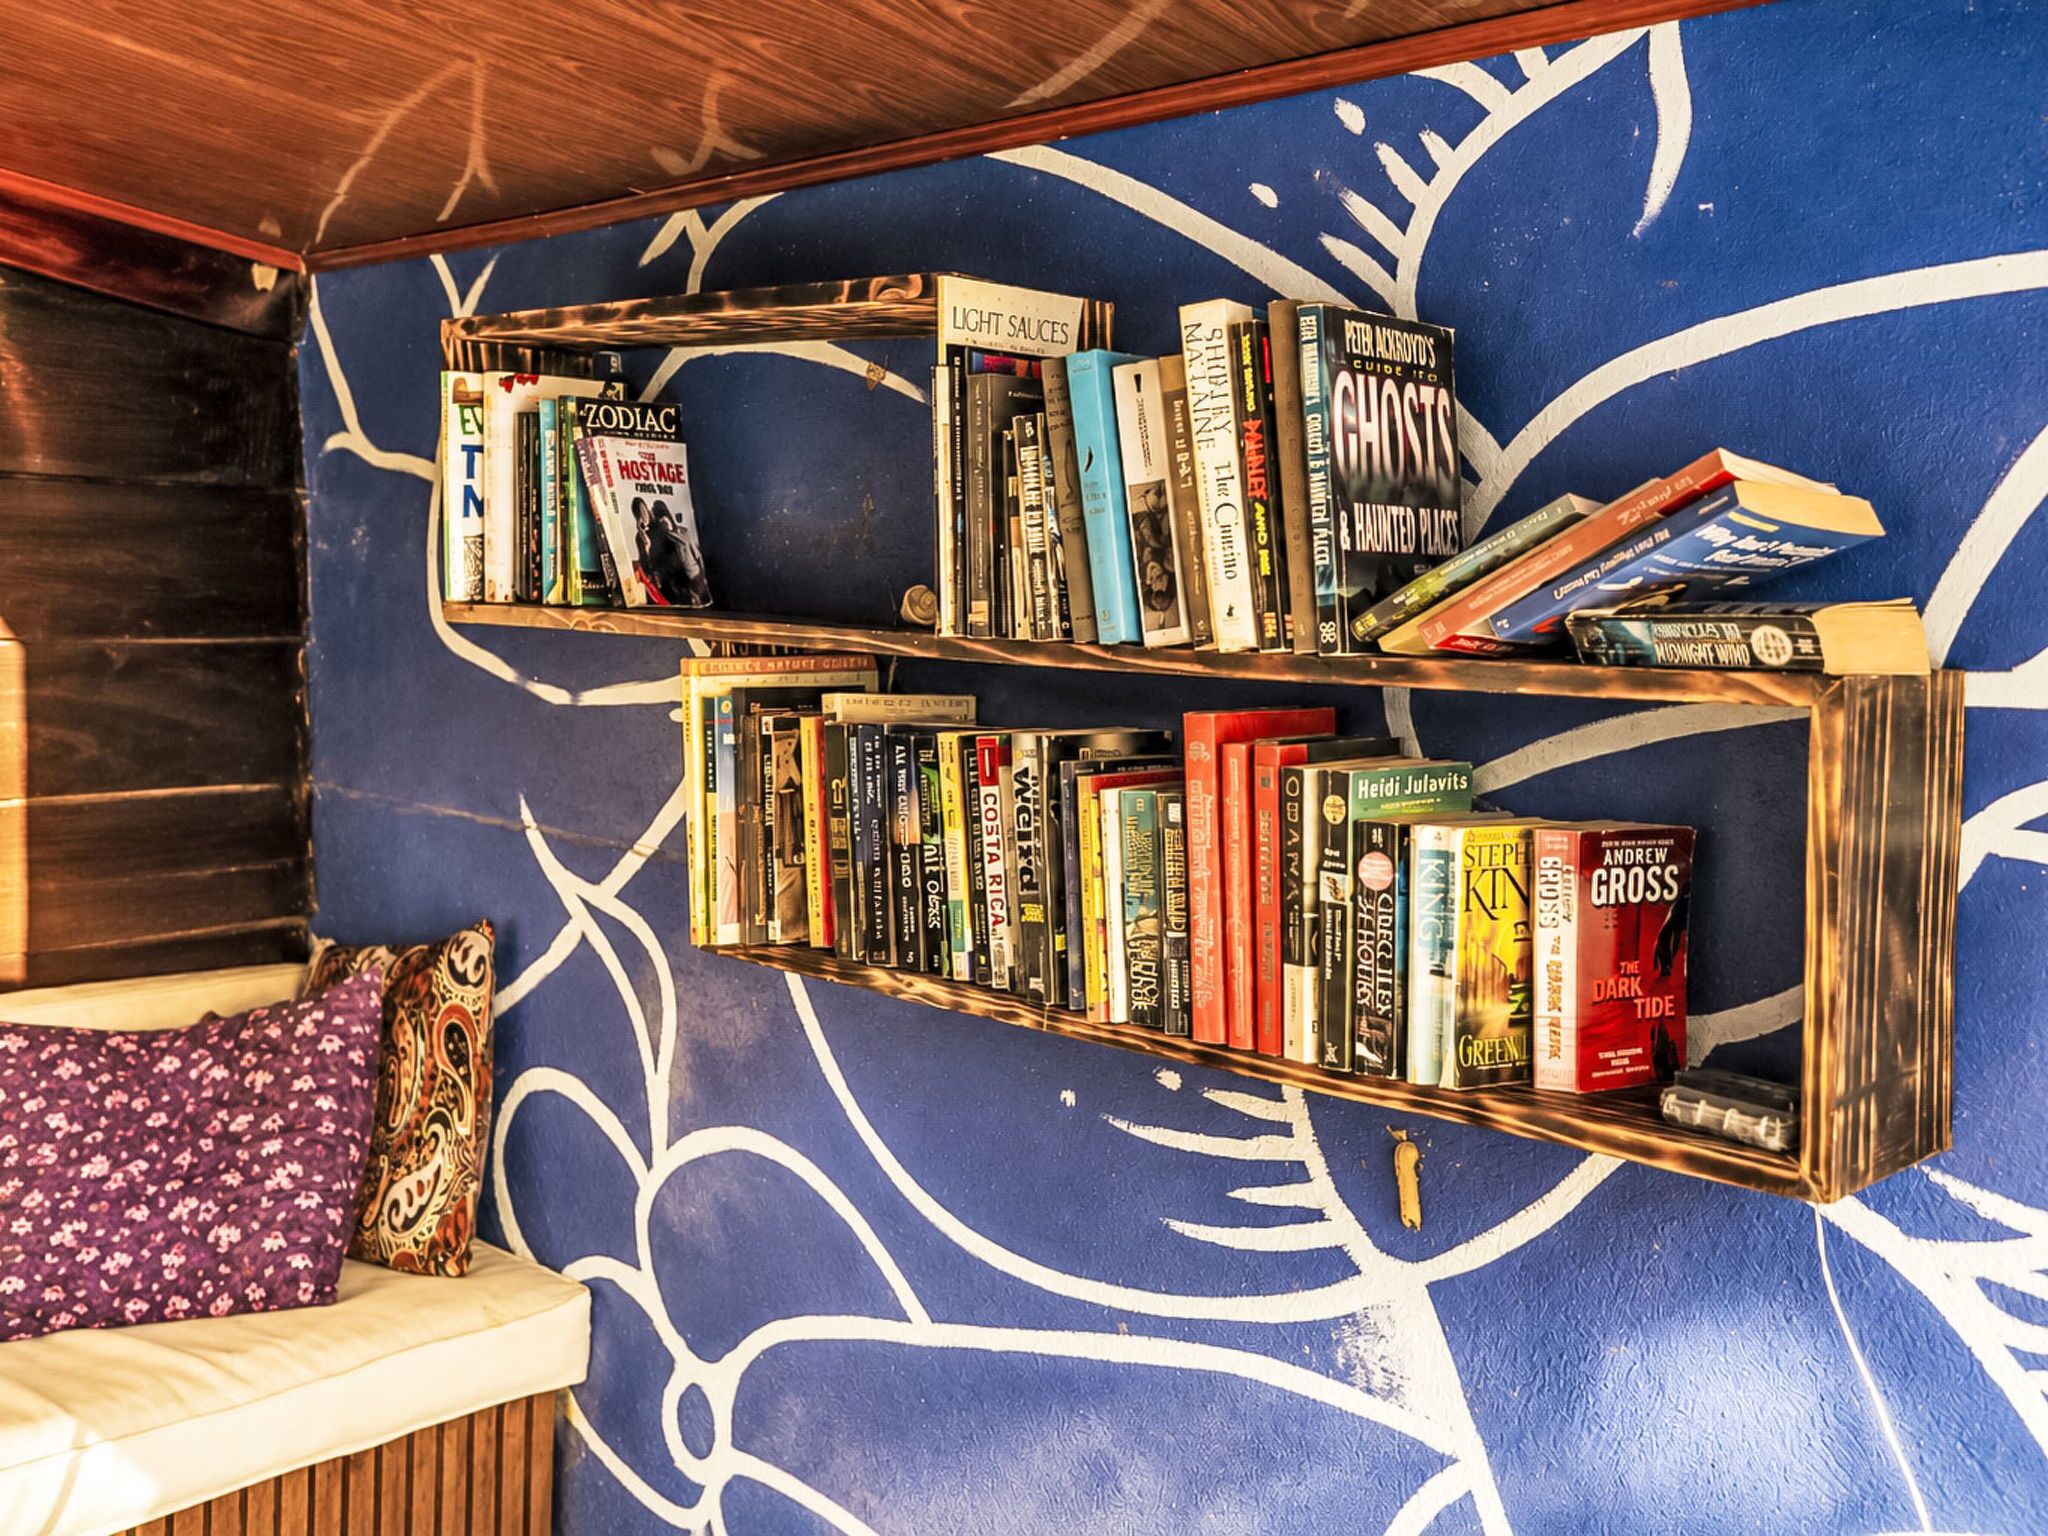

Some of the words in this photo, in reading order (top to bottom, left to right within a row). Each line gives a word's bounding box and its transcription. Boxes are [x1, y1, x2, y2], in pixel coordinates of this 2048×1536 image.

[952, 305, 1004, 335] LIGHT
[1006, 314, 1070, 345] SAUCES
[585, 403, 677, 434] ZODIAC
[1333, 370, 1455, 482] GHOSTS
[616, 458, 686, 485] HOSTAGE
[1339, 510, 1351, 552] &
[1352, 502, 1416, 554] HAUNTED
[1418, 507, 1459, 556] PLACES
[1357, 775, 1401, 800] Heidi
[1403, 771, 1469, 795] Julavits
[983, 793, 1002, 865] COSTA
[1602, 847, 1668, 866] ANDREW
[988, 874, 1006, 926] RICA
[1418, 857, 1445, 945] KING
[1591, 865, 1680, 907] GROSS
[1619, 960, 1640, 975] THE
[1592, 976, 1644, 1003] DARK
[1633, 995, 1676, 1020] TIDE
